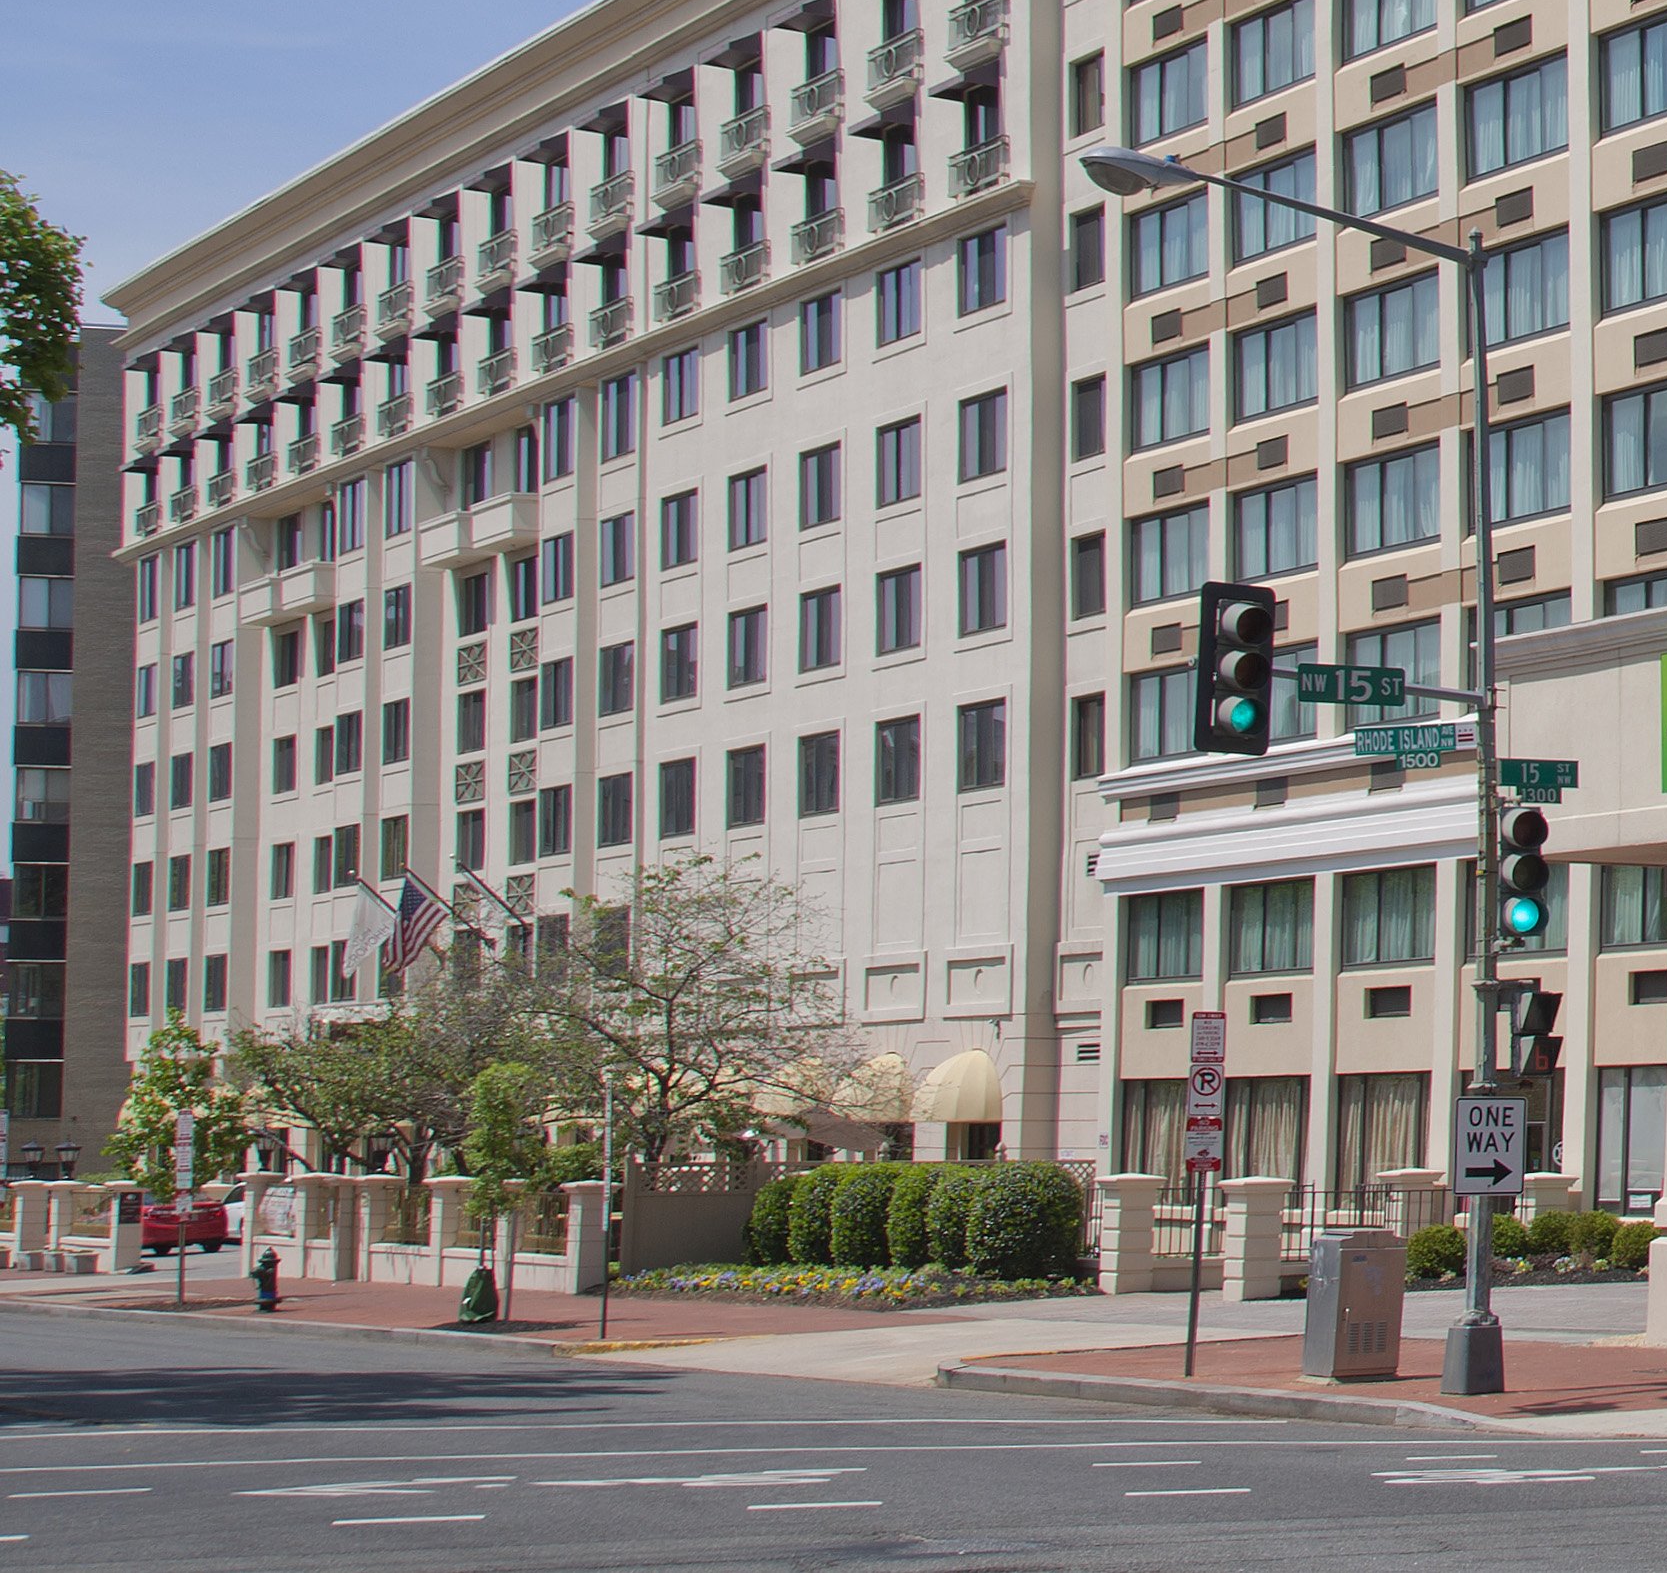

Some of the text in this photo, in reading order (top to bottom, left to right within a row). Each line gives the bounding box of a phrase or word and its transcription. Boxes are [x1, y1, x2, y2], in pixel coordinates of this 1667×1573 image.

[1302, 669, 1403, 702] NW 15 ST
[1356, 728, 1440, 752] RHODE ISLAND
[1441, 738, 1454, 748] NW
[1400, 752, 1439, 768] 1500
[1557, 763, 1571, 773] ST
[1521, 762, 1540, 784] 15
[1557, 775, 1572, 785] NW
[1521, 788, 1556, 802] 1300
[1469, 1106, 1514, 1127] ONE
[1467, 1132, 1515, 1152] WAY
